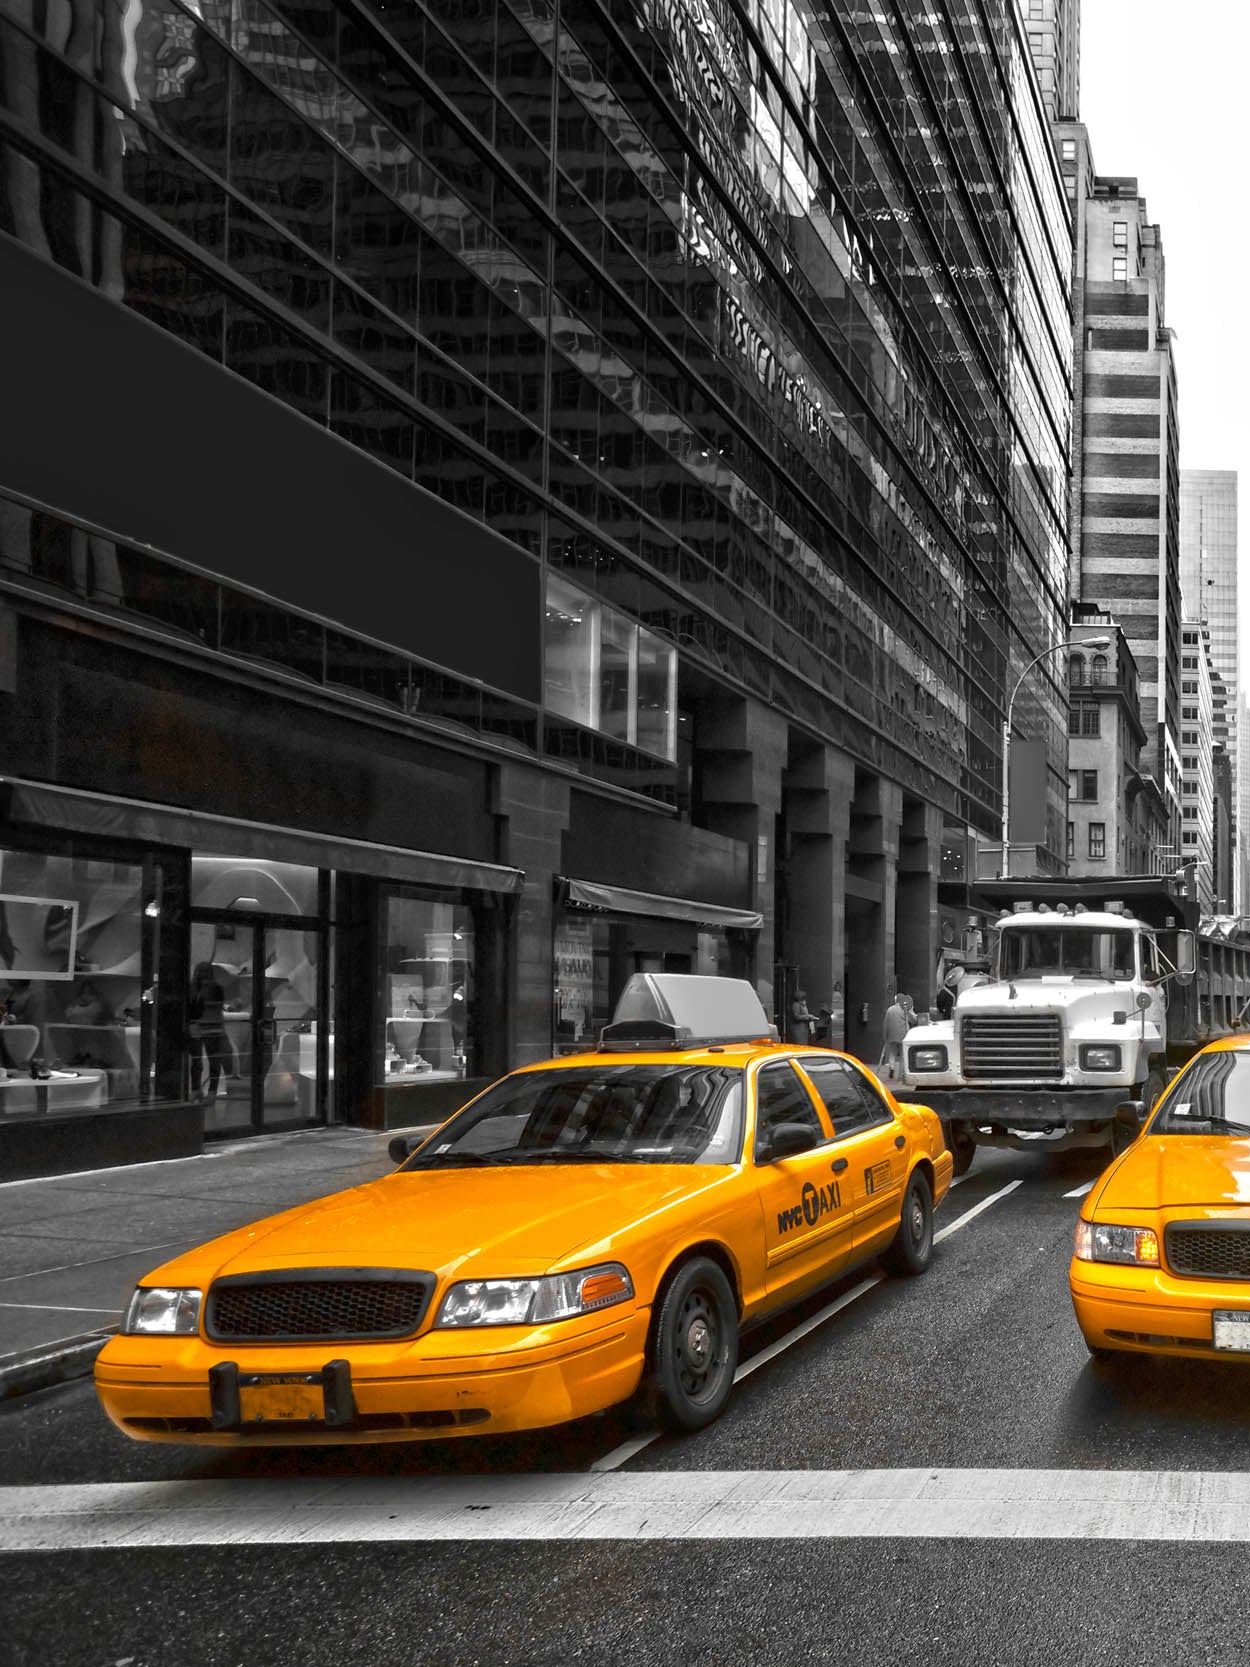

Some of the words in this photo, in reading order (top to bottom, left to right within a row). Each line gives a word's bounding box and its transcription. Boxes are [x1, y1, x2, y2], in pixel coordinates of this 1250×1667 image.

[778, 1204, 802, 1234] NYC
[802, 1181, 841, 1226] TAXI
[1232, 1314, 1250, 1322] NEW
[259, 1376, 281, 1385] NEW
[283, 1376, 306, 1384] YORK
